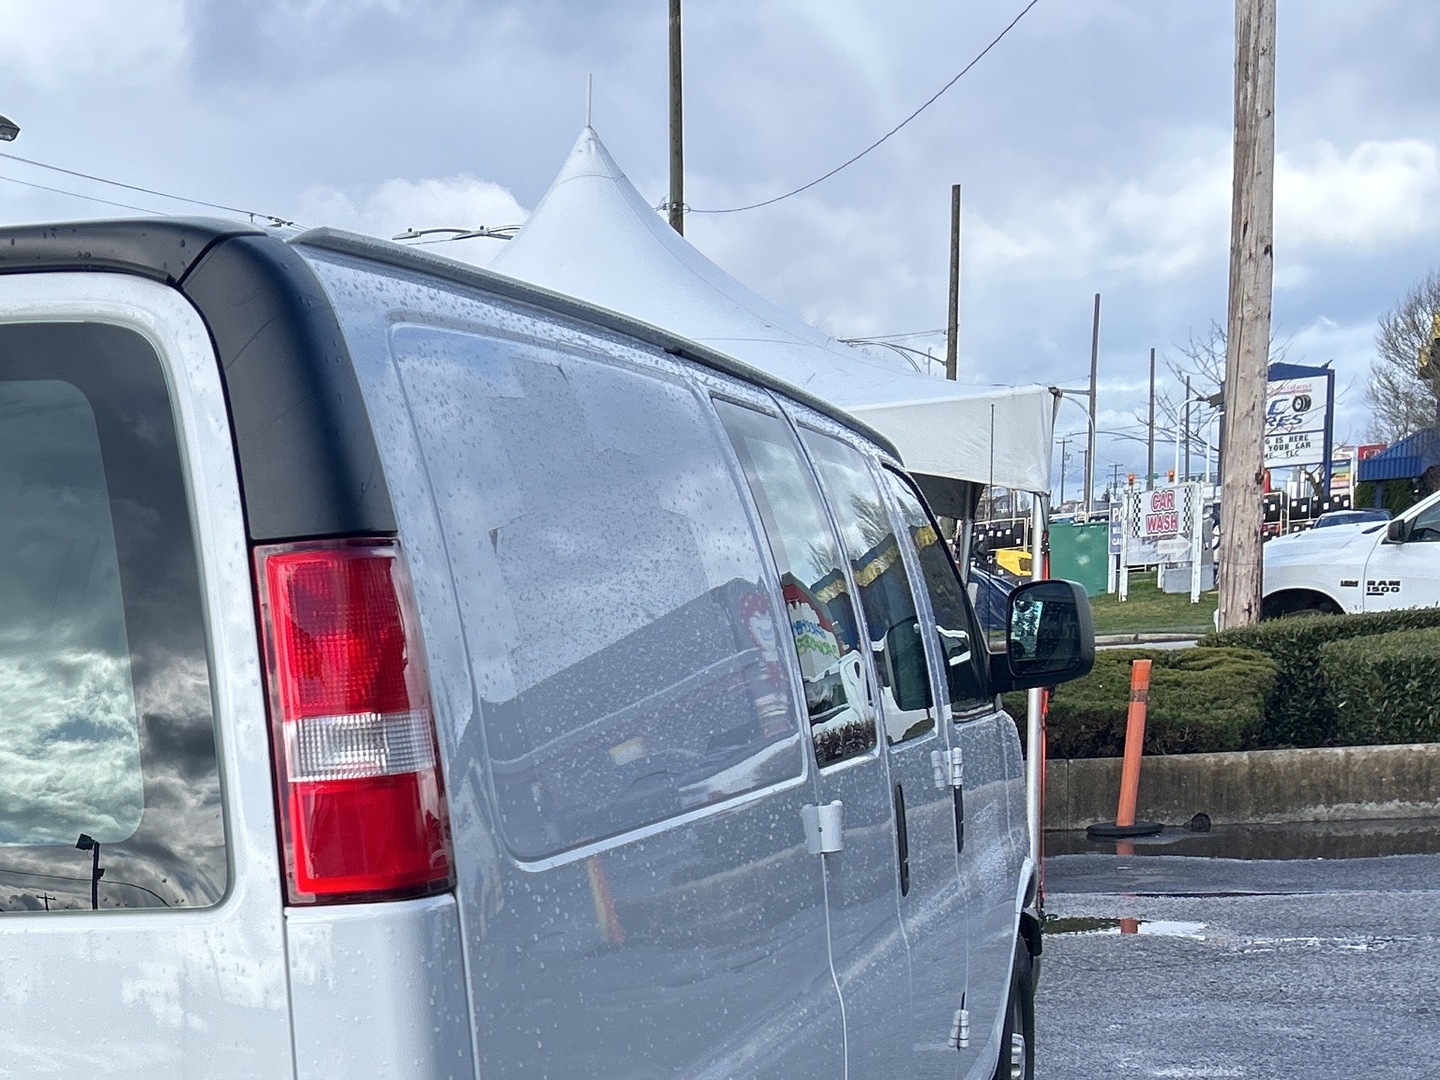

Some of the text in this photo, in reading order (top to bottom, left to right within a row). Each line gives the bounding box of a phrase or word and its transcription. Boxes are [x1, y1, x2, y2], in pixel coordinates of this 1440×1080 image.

[1288, 434, 1309, 443] HERE
[1268, 443, 1290, 451] YOUR
[1151, 490, 1175, 512] CAR
[1146, 511, 1179, 534] WASH
